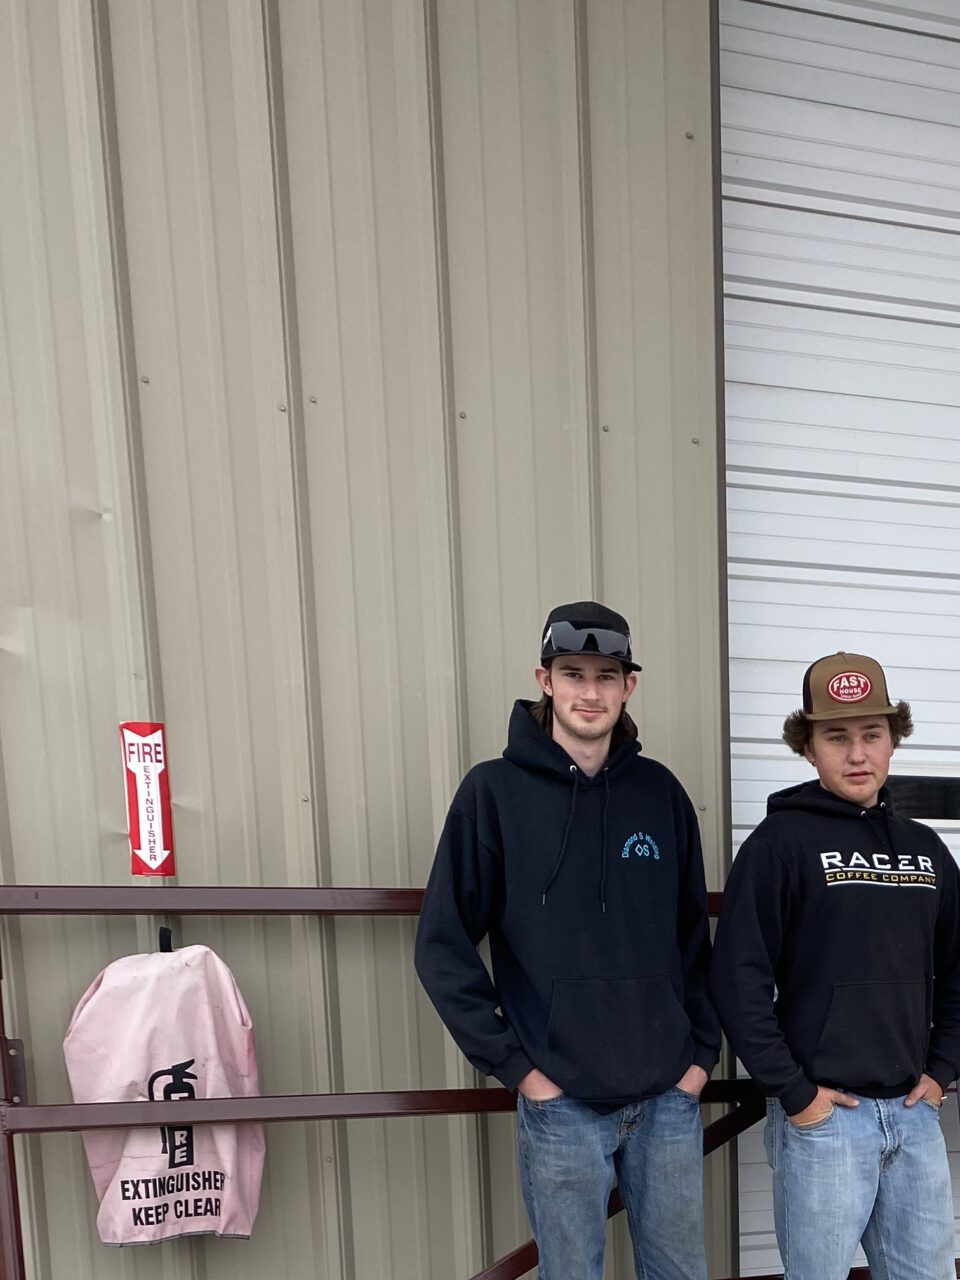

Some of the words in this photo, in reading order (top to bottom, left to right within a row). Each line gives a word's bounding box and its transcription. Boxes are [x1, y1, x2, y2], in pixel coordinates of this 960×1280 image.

[833, 676, 866, 692] FAST
[839, 687, 862, 695] HOUSE
[127, 743, 163, 763] FIRE
[143, 765, 158, 861] EXTINGUISHER
[820, 851, 935, 873] RACER
[825, 872, 877, 882] COFFEE
[882, 874, 936, 885] COMPANY
[120, 1170, 226, 1201] EXTINGUISHER
[132, 1203, 169, 1226] KEEP
[174, 1197, 221, 1219] CLEAR
